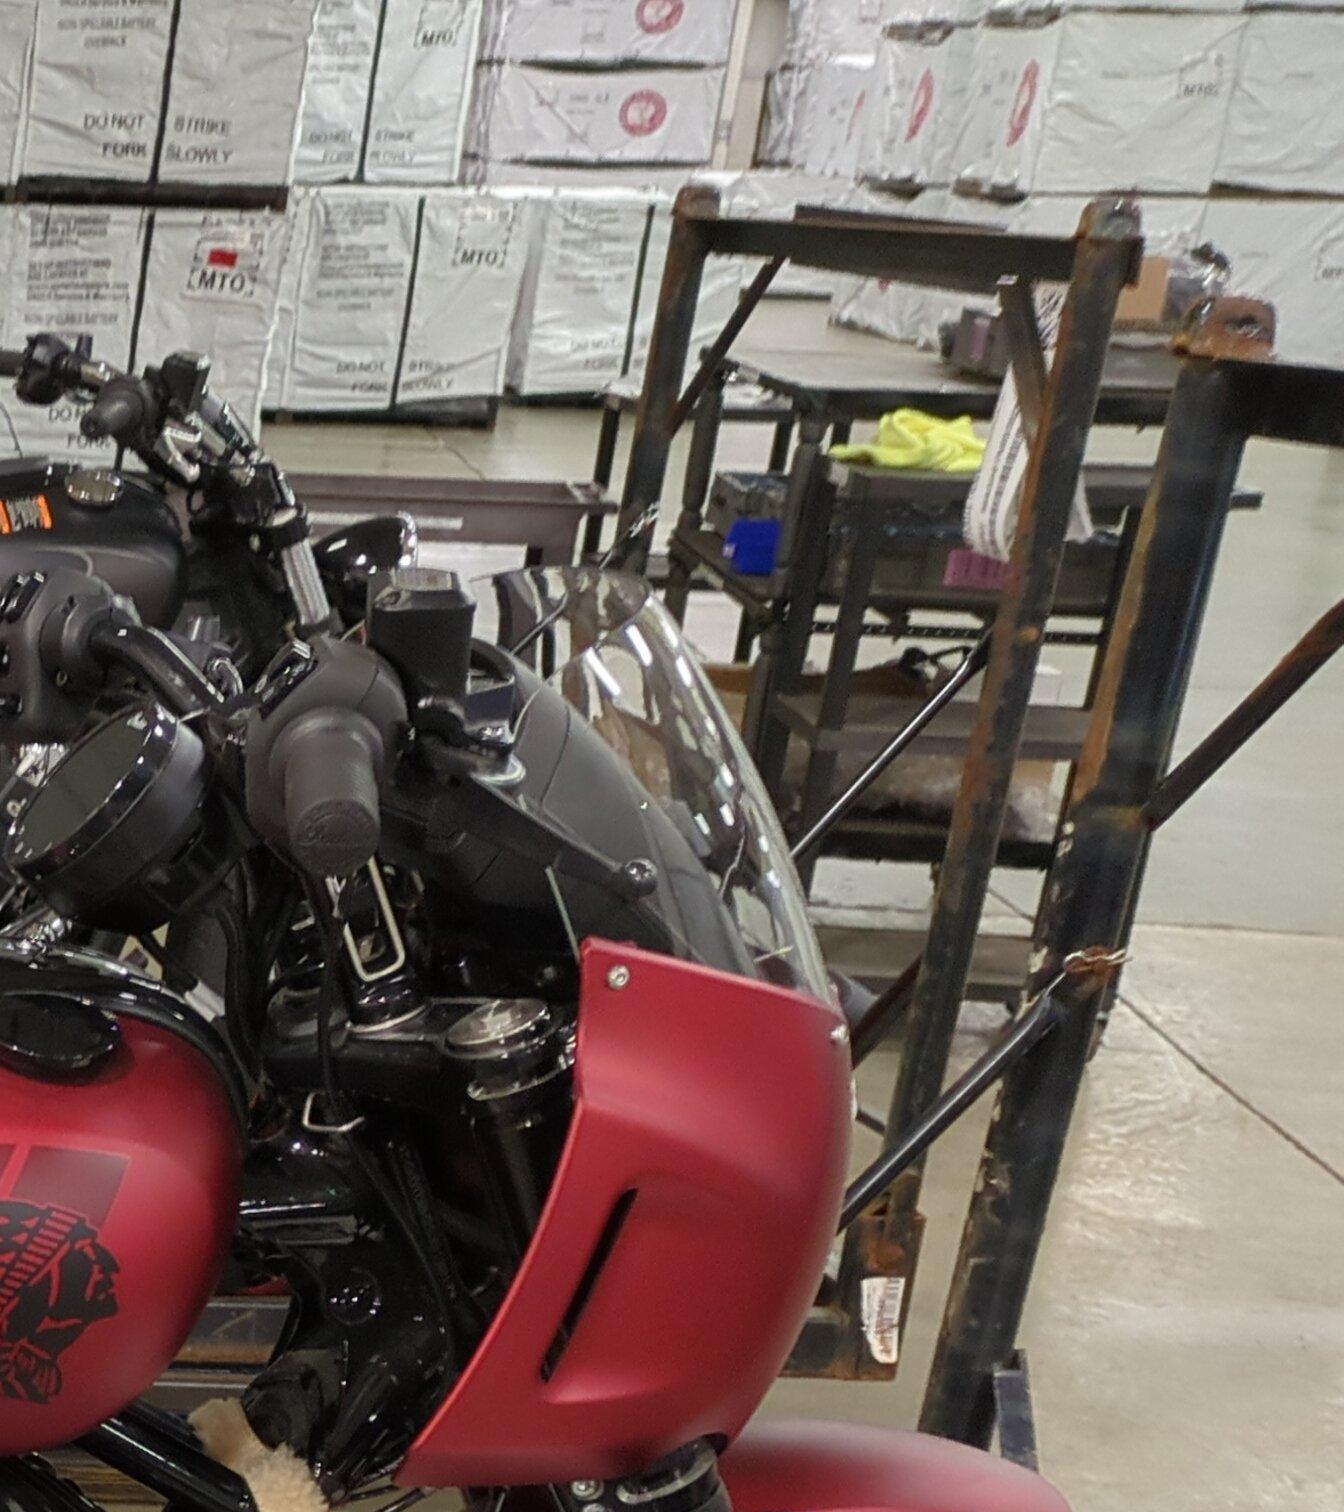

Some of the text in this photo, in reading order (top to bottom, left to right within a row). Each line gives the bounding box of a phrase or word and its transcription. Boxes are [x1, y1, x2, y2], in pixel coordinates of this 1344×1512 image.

[83, 113, 145, 130] DO NOT
[174, 117, 231, 137] STRIKE
[101, 142, 147, 158] FORK
[165, 144, 233, 164] SLOWLY
[460, 249, 499, 266] MTO
[198, 271, 246, 295] MTO
[48, 406, 71, 422] DO
